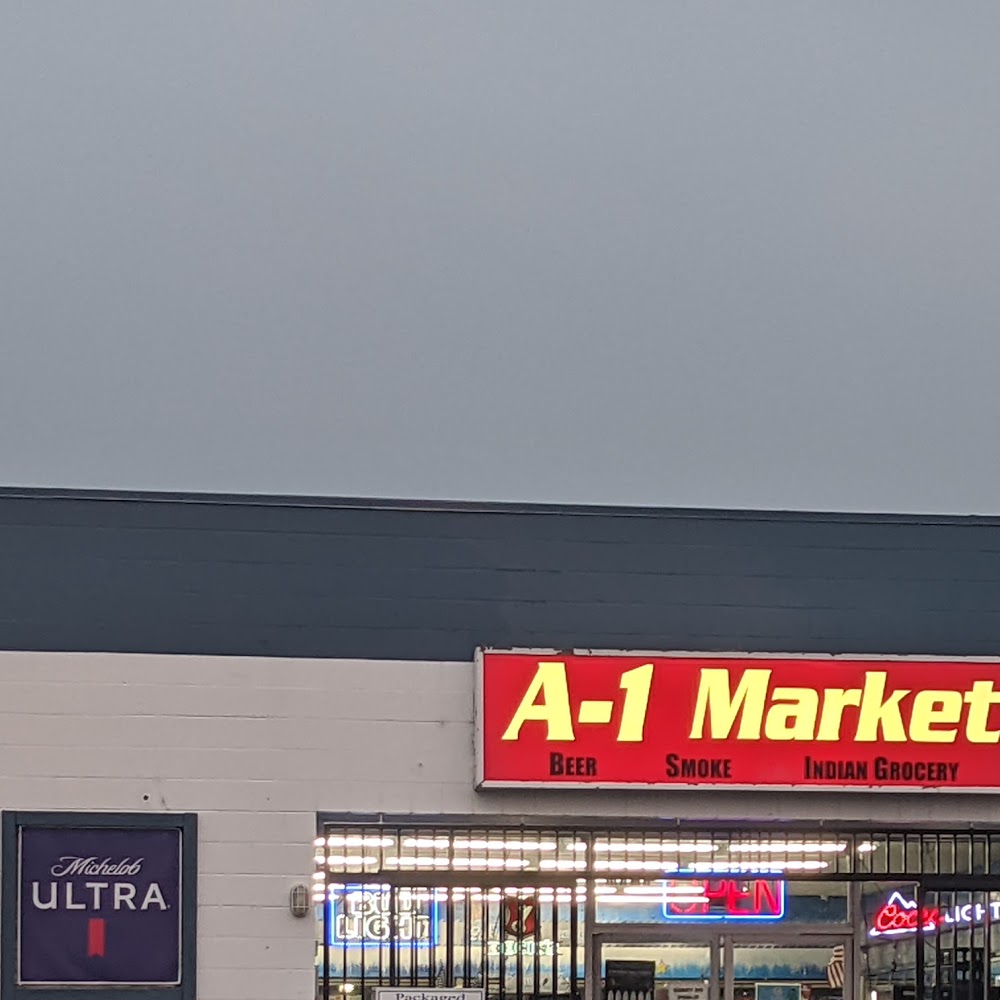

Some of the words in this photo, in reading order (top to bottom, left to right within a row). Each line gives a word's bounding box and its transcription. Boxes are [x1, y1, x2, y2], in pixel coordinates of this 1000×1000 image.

[501, 661, 654, 742] A-1
[549, 752, 597, 777] BEER
[665, 753, 732, 779] SMOKE
[804, 756, 868, 781] INDIAN
[874, 756, 960, 782] GROCERY
[51, 856, 145, 877] Michelob
[32, 881, 168, 910] ULTRA
[669, 878, 781, 914] OPEN
